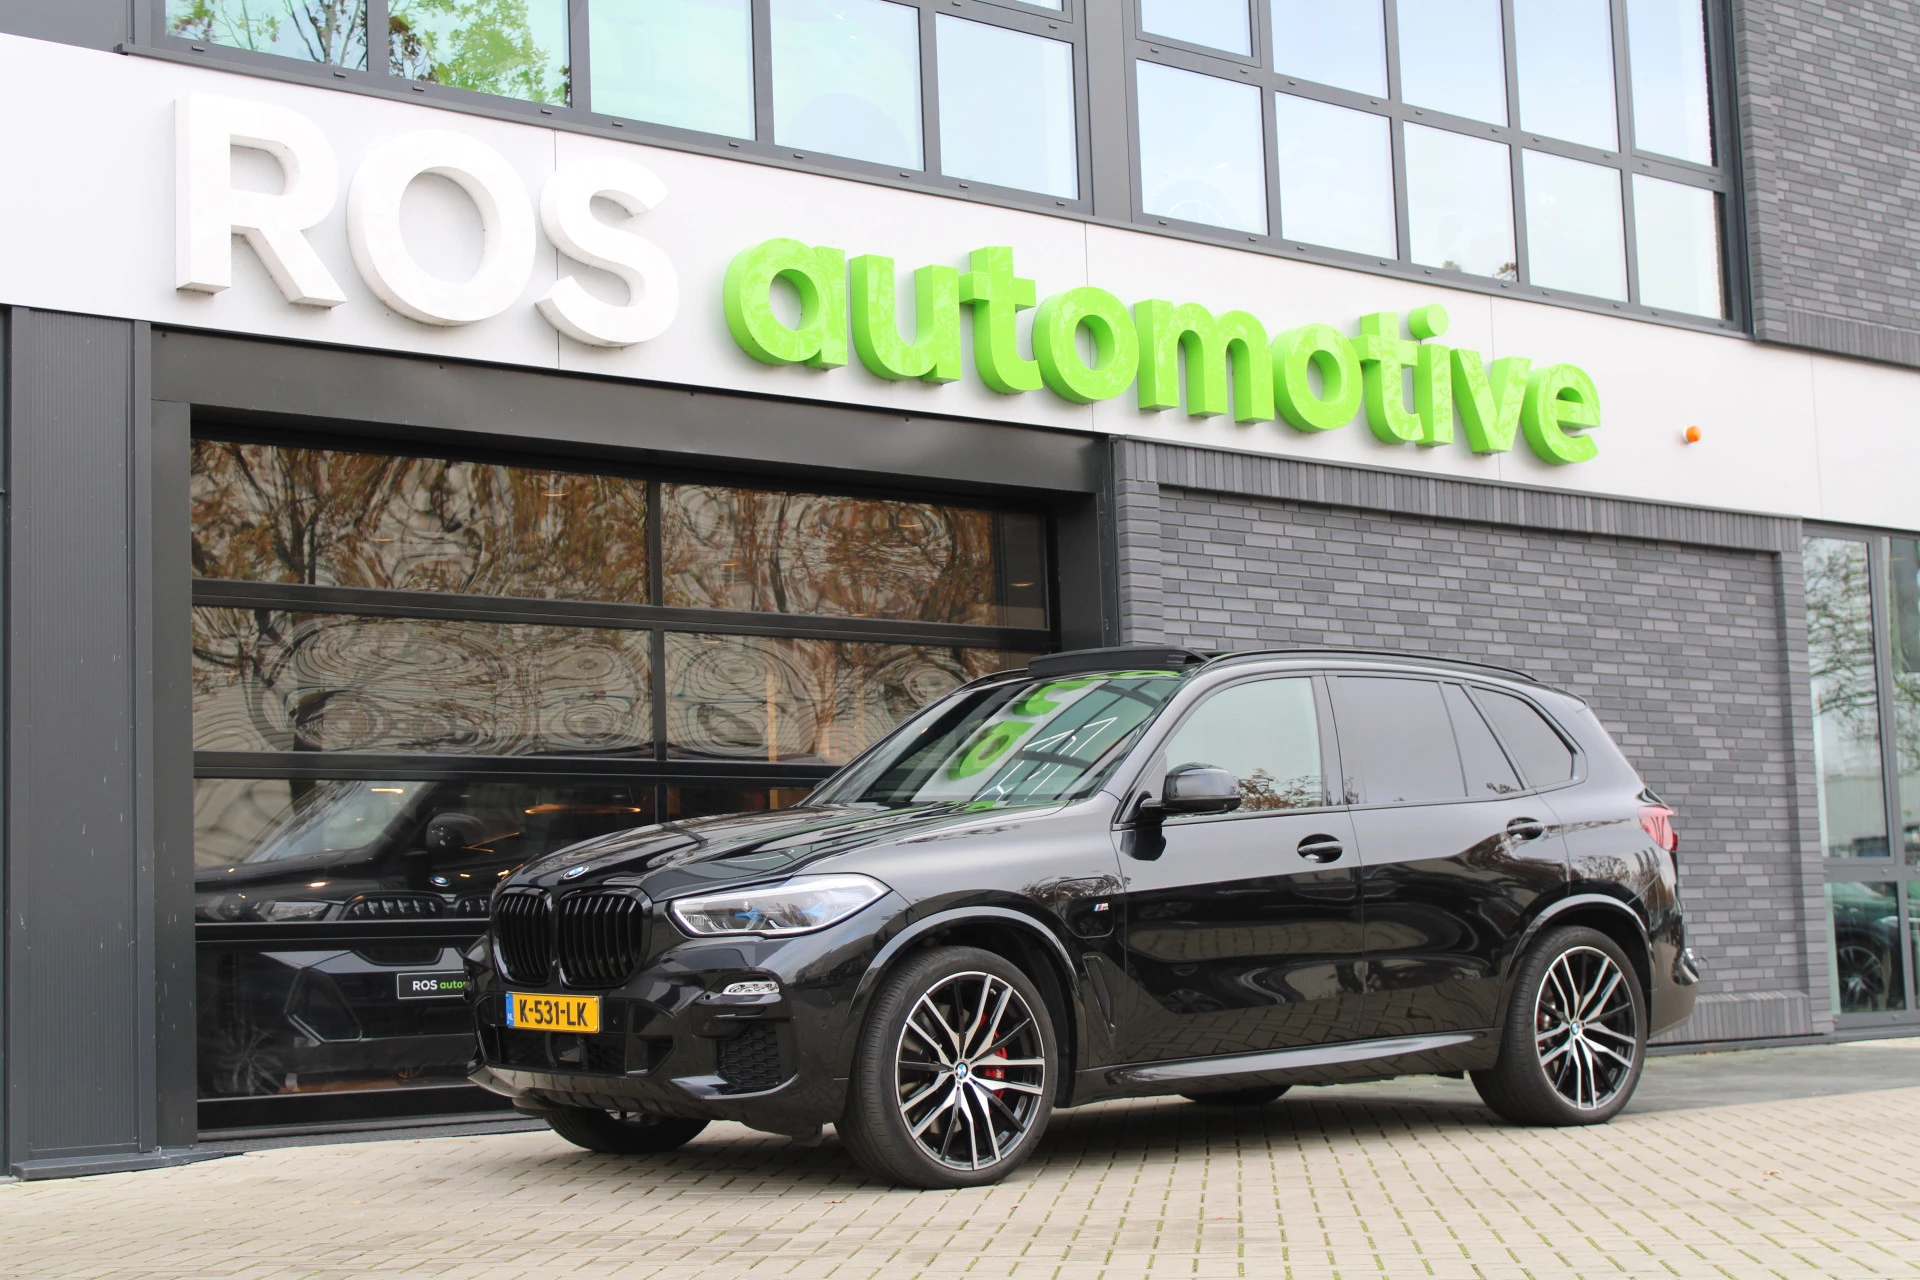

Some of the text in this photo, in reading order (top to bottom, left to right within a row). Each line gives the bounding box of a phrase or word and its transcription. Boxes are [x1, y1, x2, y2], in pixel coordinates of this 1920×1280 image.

[175, 92, 1599, 465] ROS automotive
[412, 980, 466, 991] ROS auto
[519, 999, 588, 1027] K-531-LK
